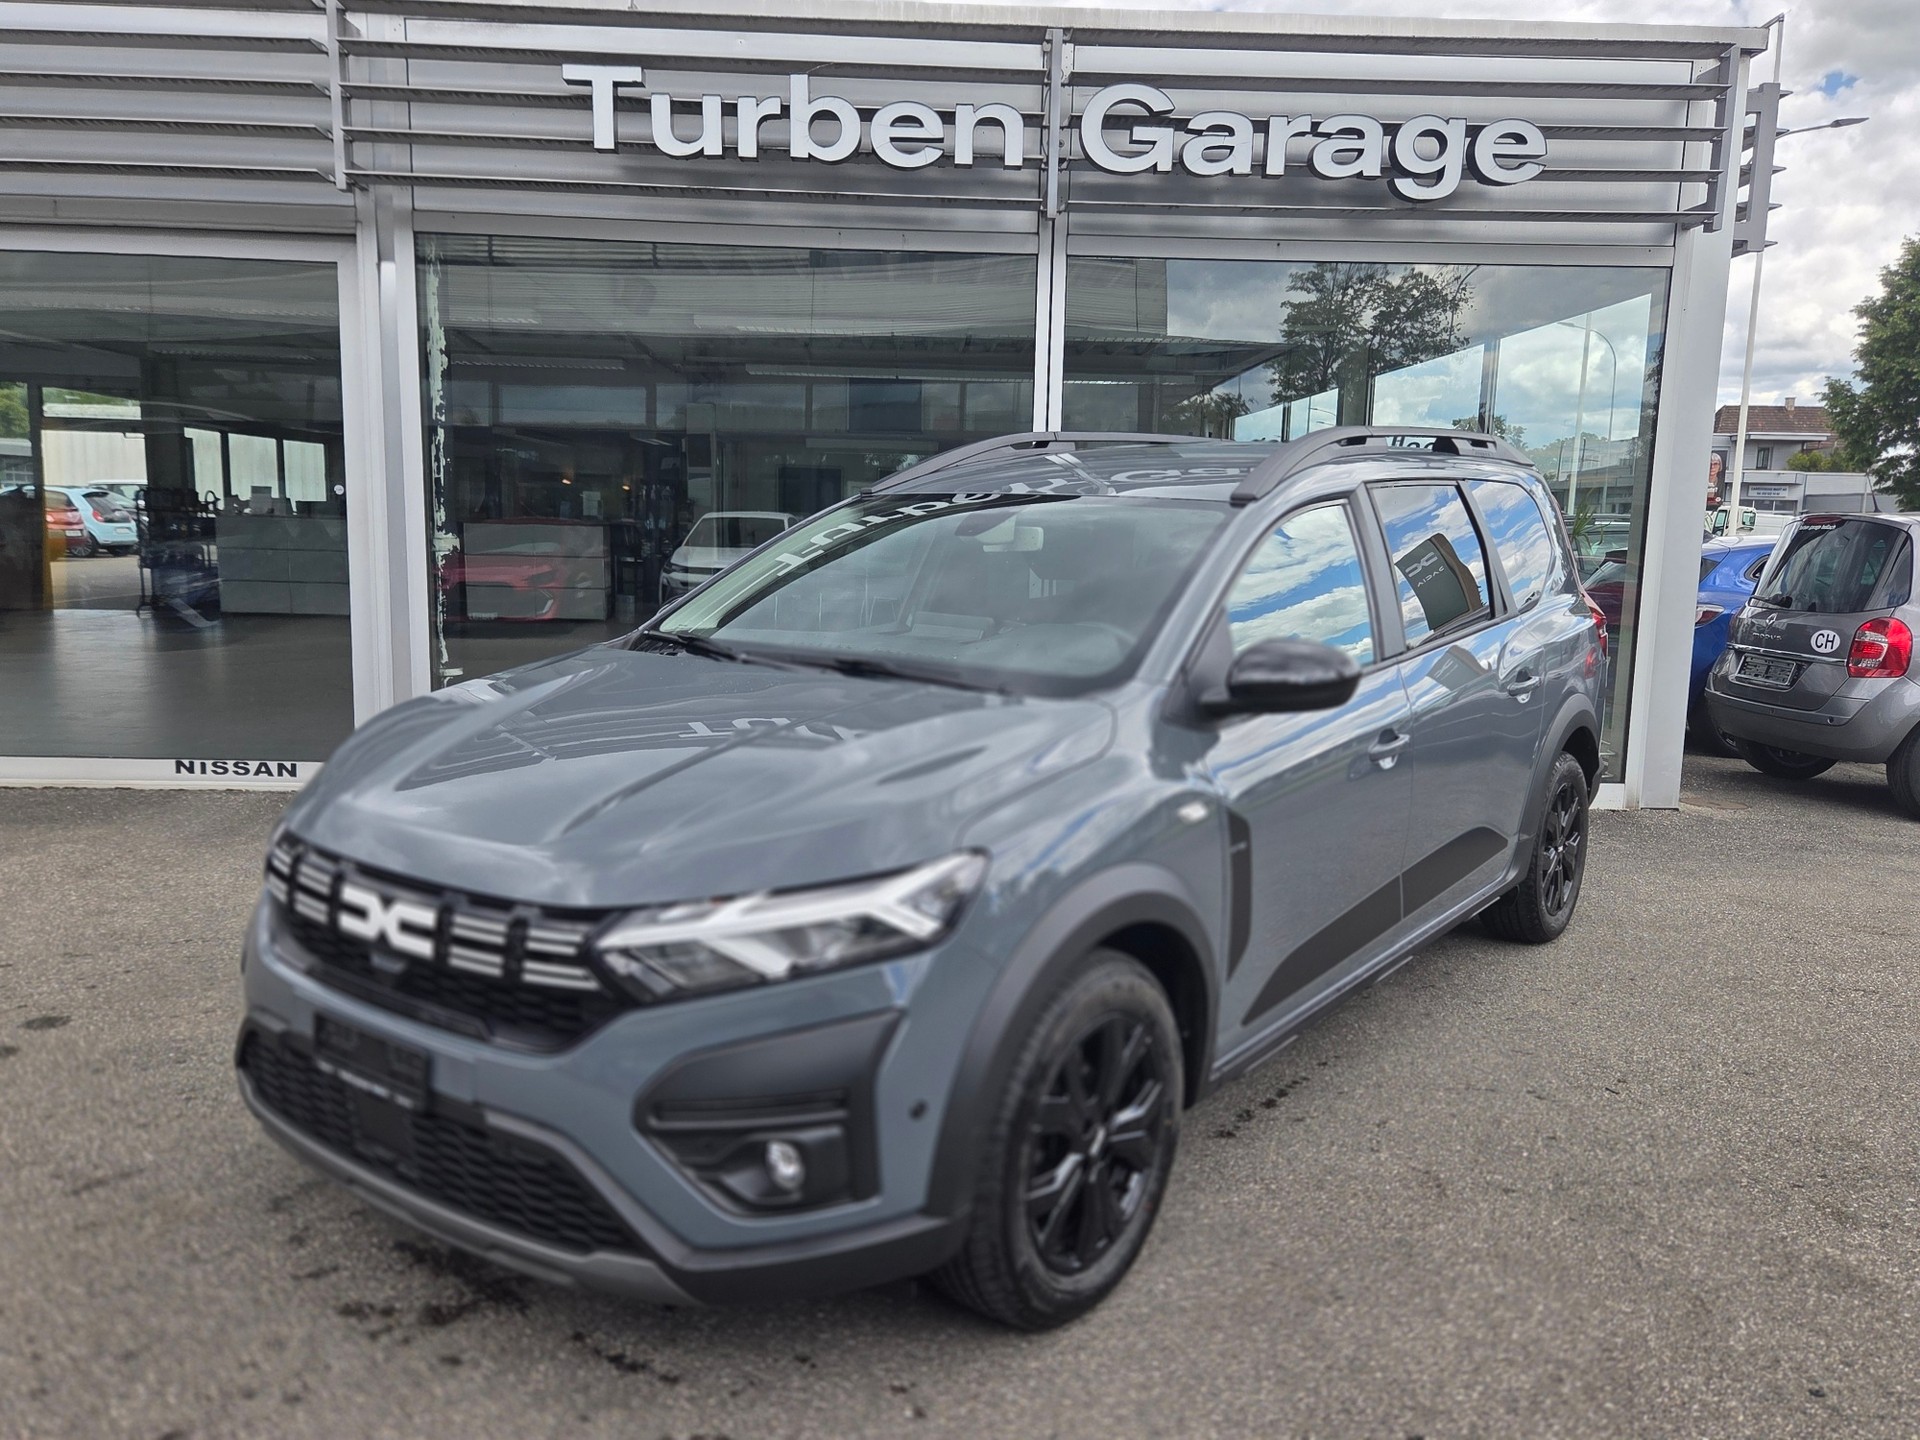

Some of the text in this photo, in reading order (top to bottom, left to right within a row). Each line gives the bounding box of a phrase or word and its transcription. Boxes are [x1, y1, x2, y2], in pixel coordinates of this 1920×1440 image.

[561, 63, 1548, 202] Turben Garage
[1814, 632, 1836, 650] CH
[174, 759, 298, 778] NISSAN
